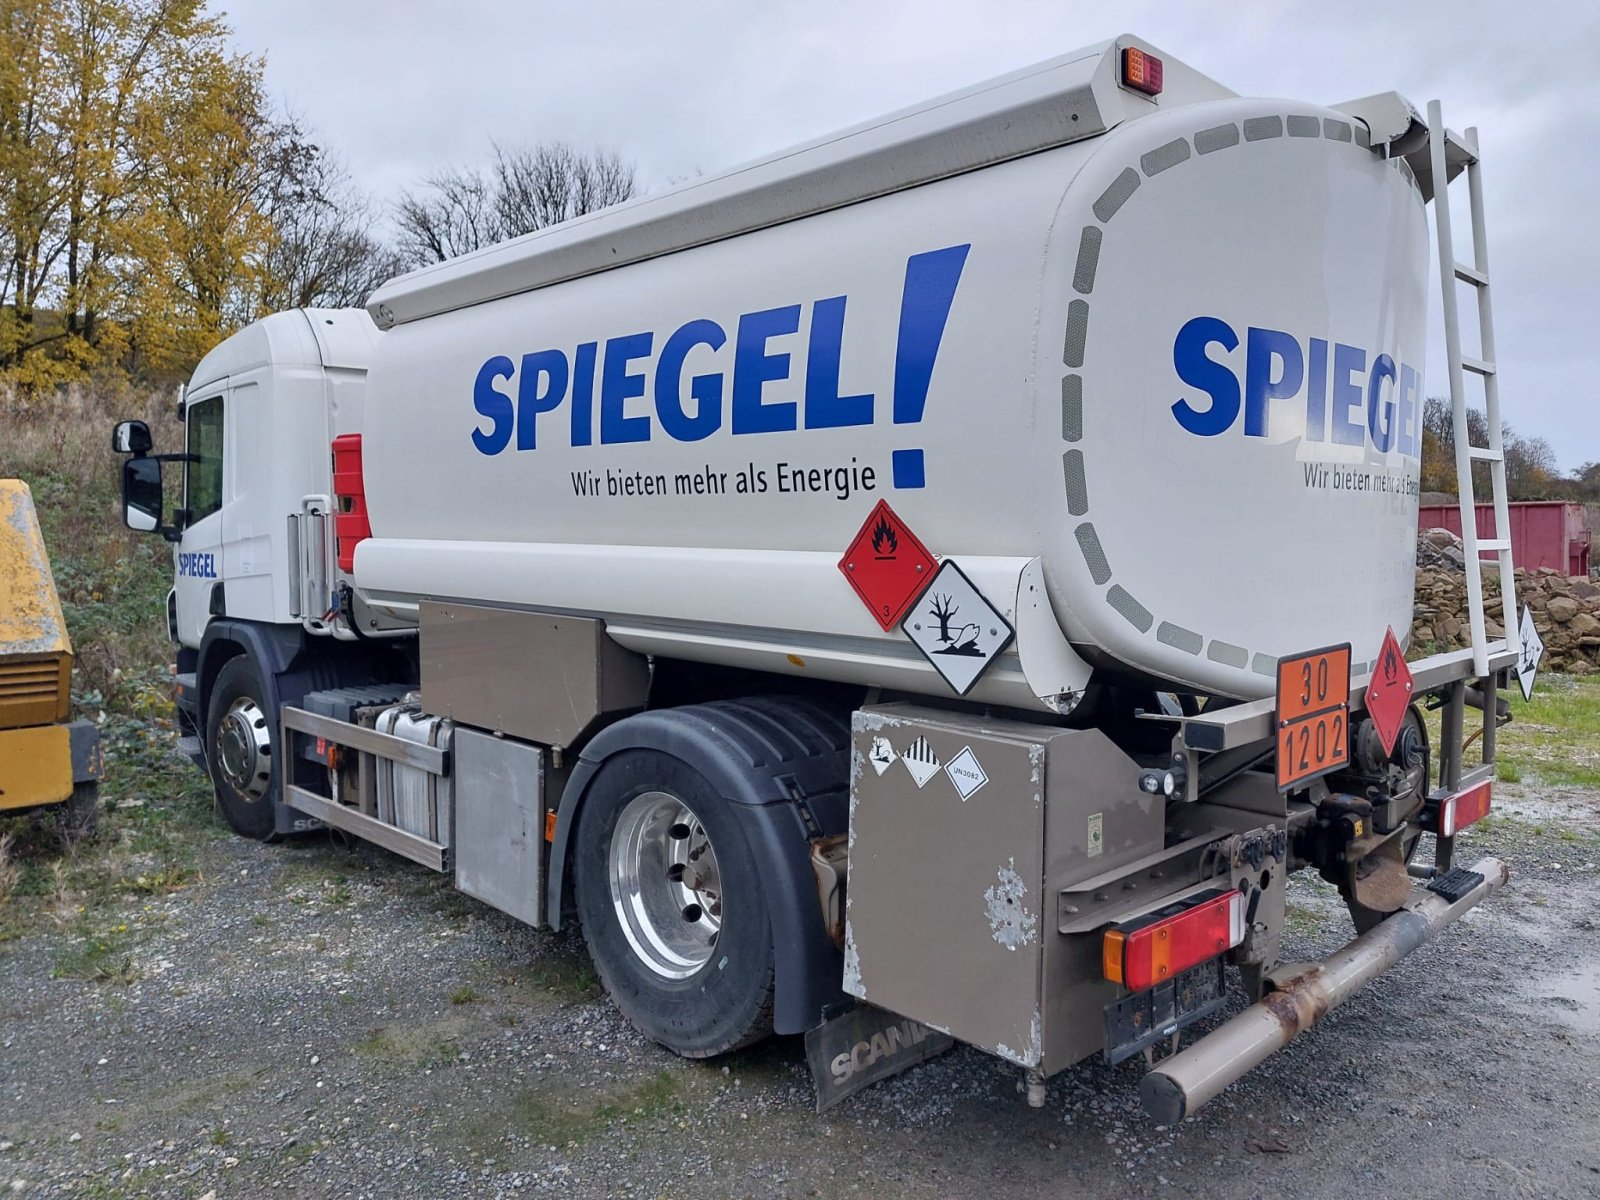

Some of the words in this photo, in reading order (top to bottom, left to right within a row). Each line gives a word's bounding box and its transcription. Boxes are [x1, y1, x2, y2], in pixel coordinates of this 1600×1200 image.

[571, 470, 602, 498] Wir
[607, 467, 667, 497] bieten
[675, 464, 728, 496] mehr
[735, 462, 769, 494] als
[777, 457, 877, 501] Energie
[1304, 462, 1329, 488] Wir
[1333, 464, 1370, 491] bieten
[1373, 468, 1394, 493] mehr
[178, 552, 217, 578] SPIEGEL
[883, 605, 890, 618] 3
[1301, 657, 1328, 705] 30
[1286, 715, 1343, 775] 1202
